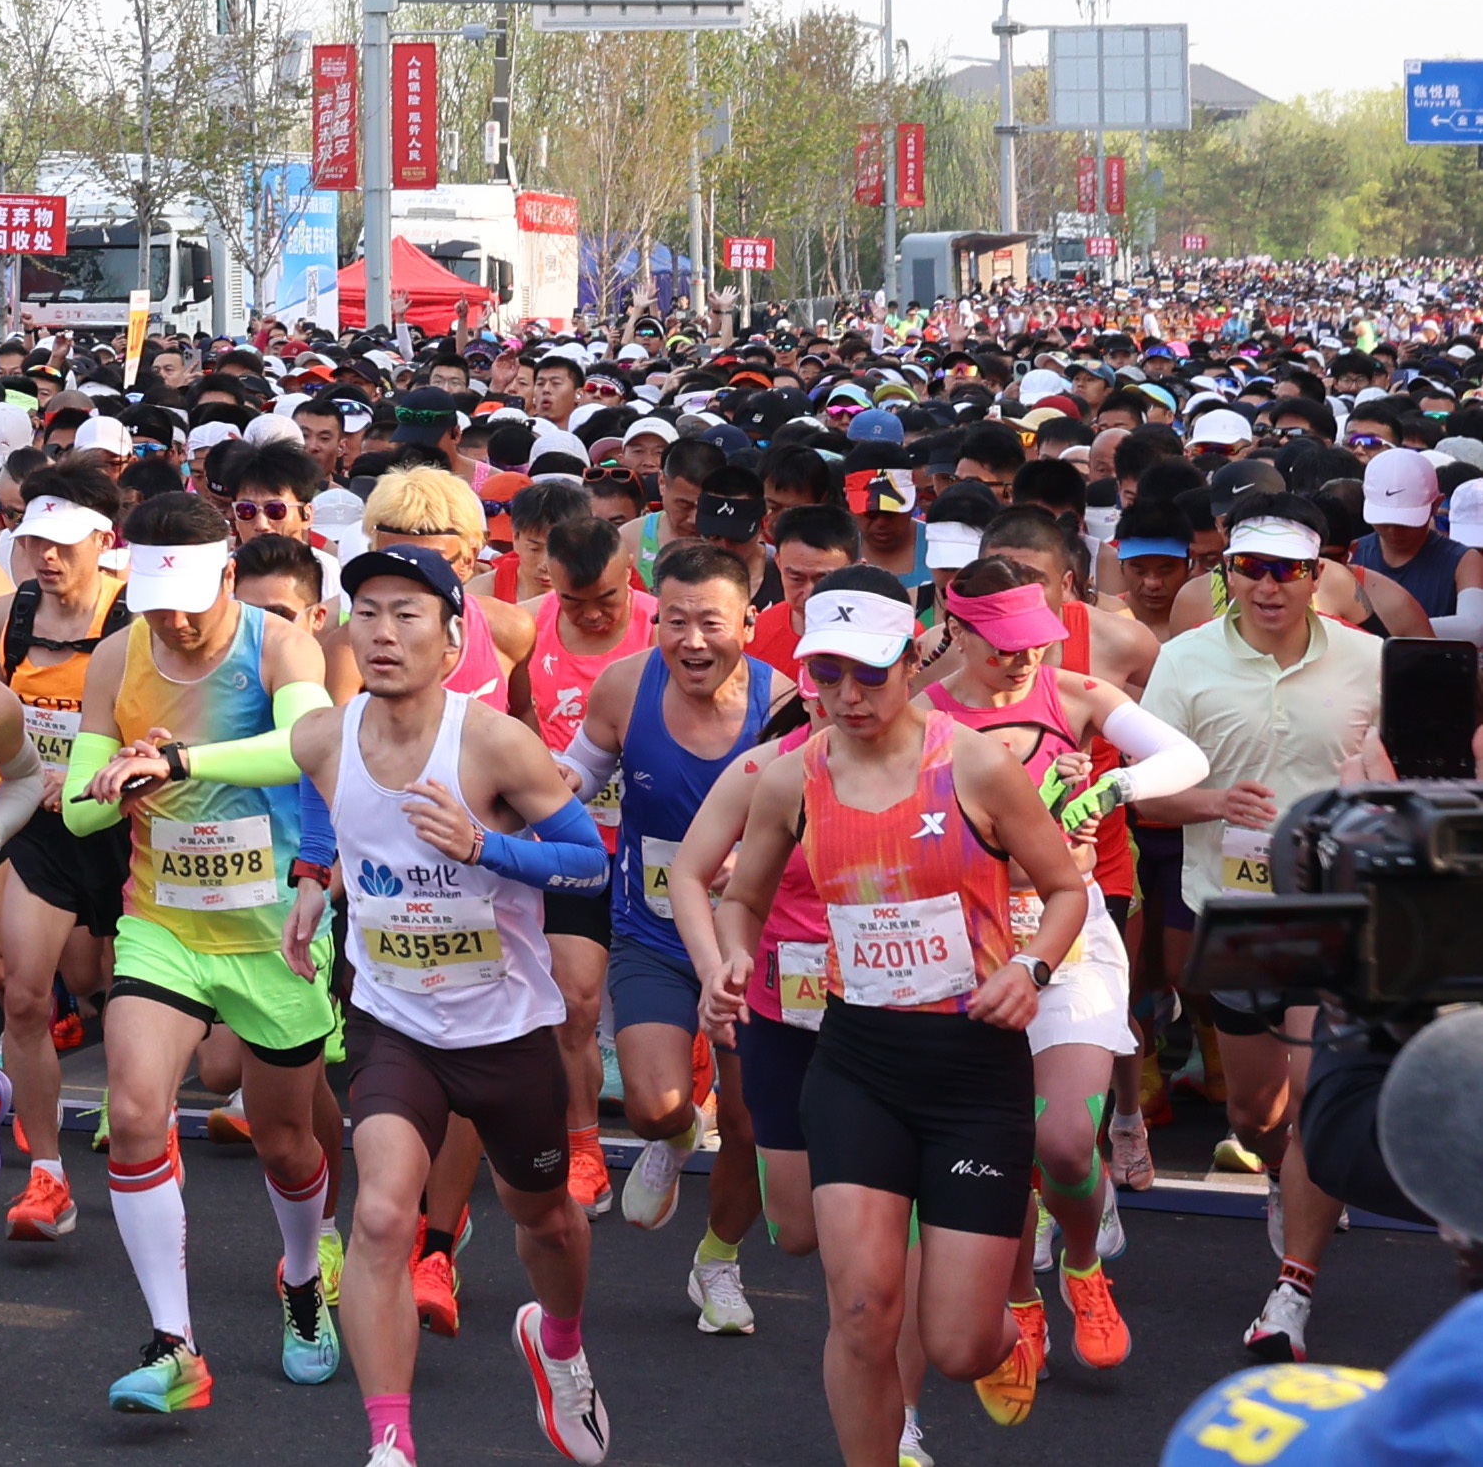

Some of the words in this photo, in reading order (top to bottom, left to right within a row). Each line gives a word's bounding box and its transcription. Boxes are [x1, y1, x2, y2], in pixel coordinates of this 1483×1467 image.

[34, 711, 53, 721] PICC
[193, 825, 219, 835] PICC
[178, 835, 236, 845] 中国人民保险
[161, 850, 264, 877] A38898
[406, 863, 460, 888] 中化
[412, 887, 462, 900] sinochem
[405, 902, 433, 913] PICC
[873, 907, 901, 919] PICC
[390, 914, 453, 925] 中国人民保险
[379, 931, 484, 960] A35521
[852, 935, 950, 969] A20113
